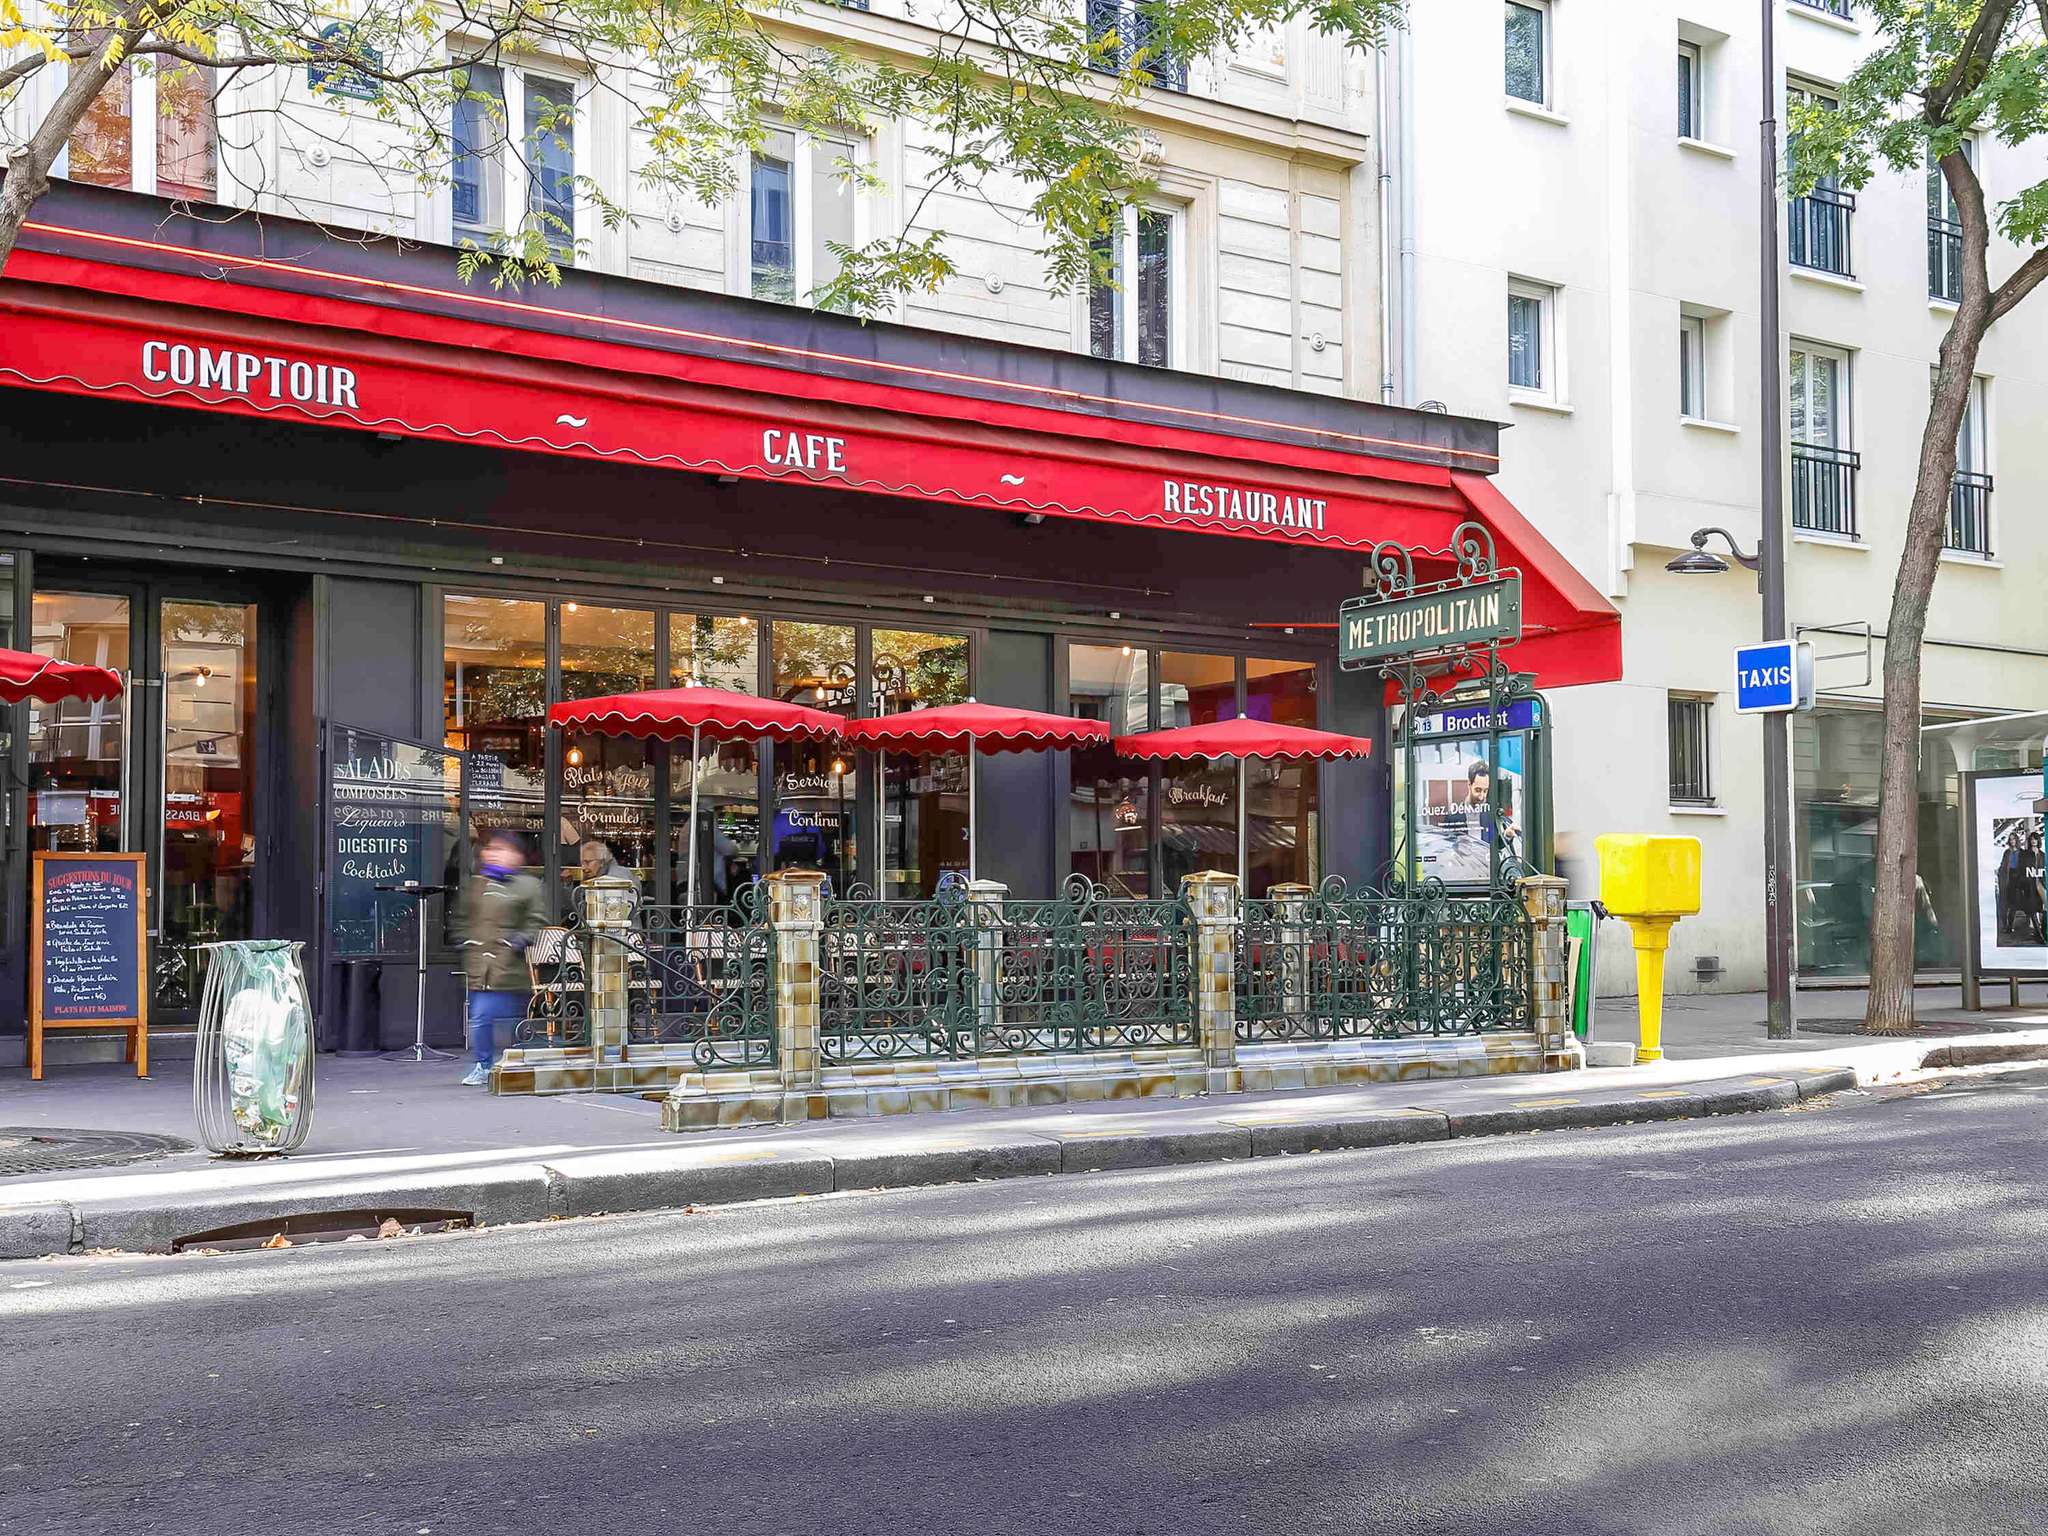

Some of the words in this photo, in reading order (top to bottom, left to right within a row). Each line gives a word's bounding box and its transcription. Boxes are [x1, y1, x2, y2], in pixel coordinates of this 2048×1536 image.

[142, 340, 360, 409] COMPTOIR
[763, 429, 847, 473] CAFE
[1163, 479, 1327, 531] RESTAURANT
[1348, 592, 1499, 650] METROPOLITAIN
[1739, 665, 1791, 689] TAXIS
[1422, 720, 1432, 732] 13
[336, 756, 412, 781] SALADES
[563, 767, 603, 788] Plats
[334, 784, 407, 800] COMPOSÉES
[1168, 784, 1229, 808] Breakfast
[337, 805, 406, 834] Liqueurs
[577, 803, 639, 823] Formules
[789, 809, 840, 827] Continu
[338, 838, 408, 854] DIGESTIFS
[342, 858, 406, 879] Cocktails
[48, 870, 100, 889] SUGGESTIONS
[101, 871, 111, 884] DU
[112, 873, 132, 891] JOUR
[97, 1004, 128, 1013] MAISON
